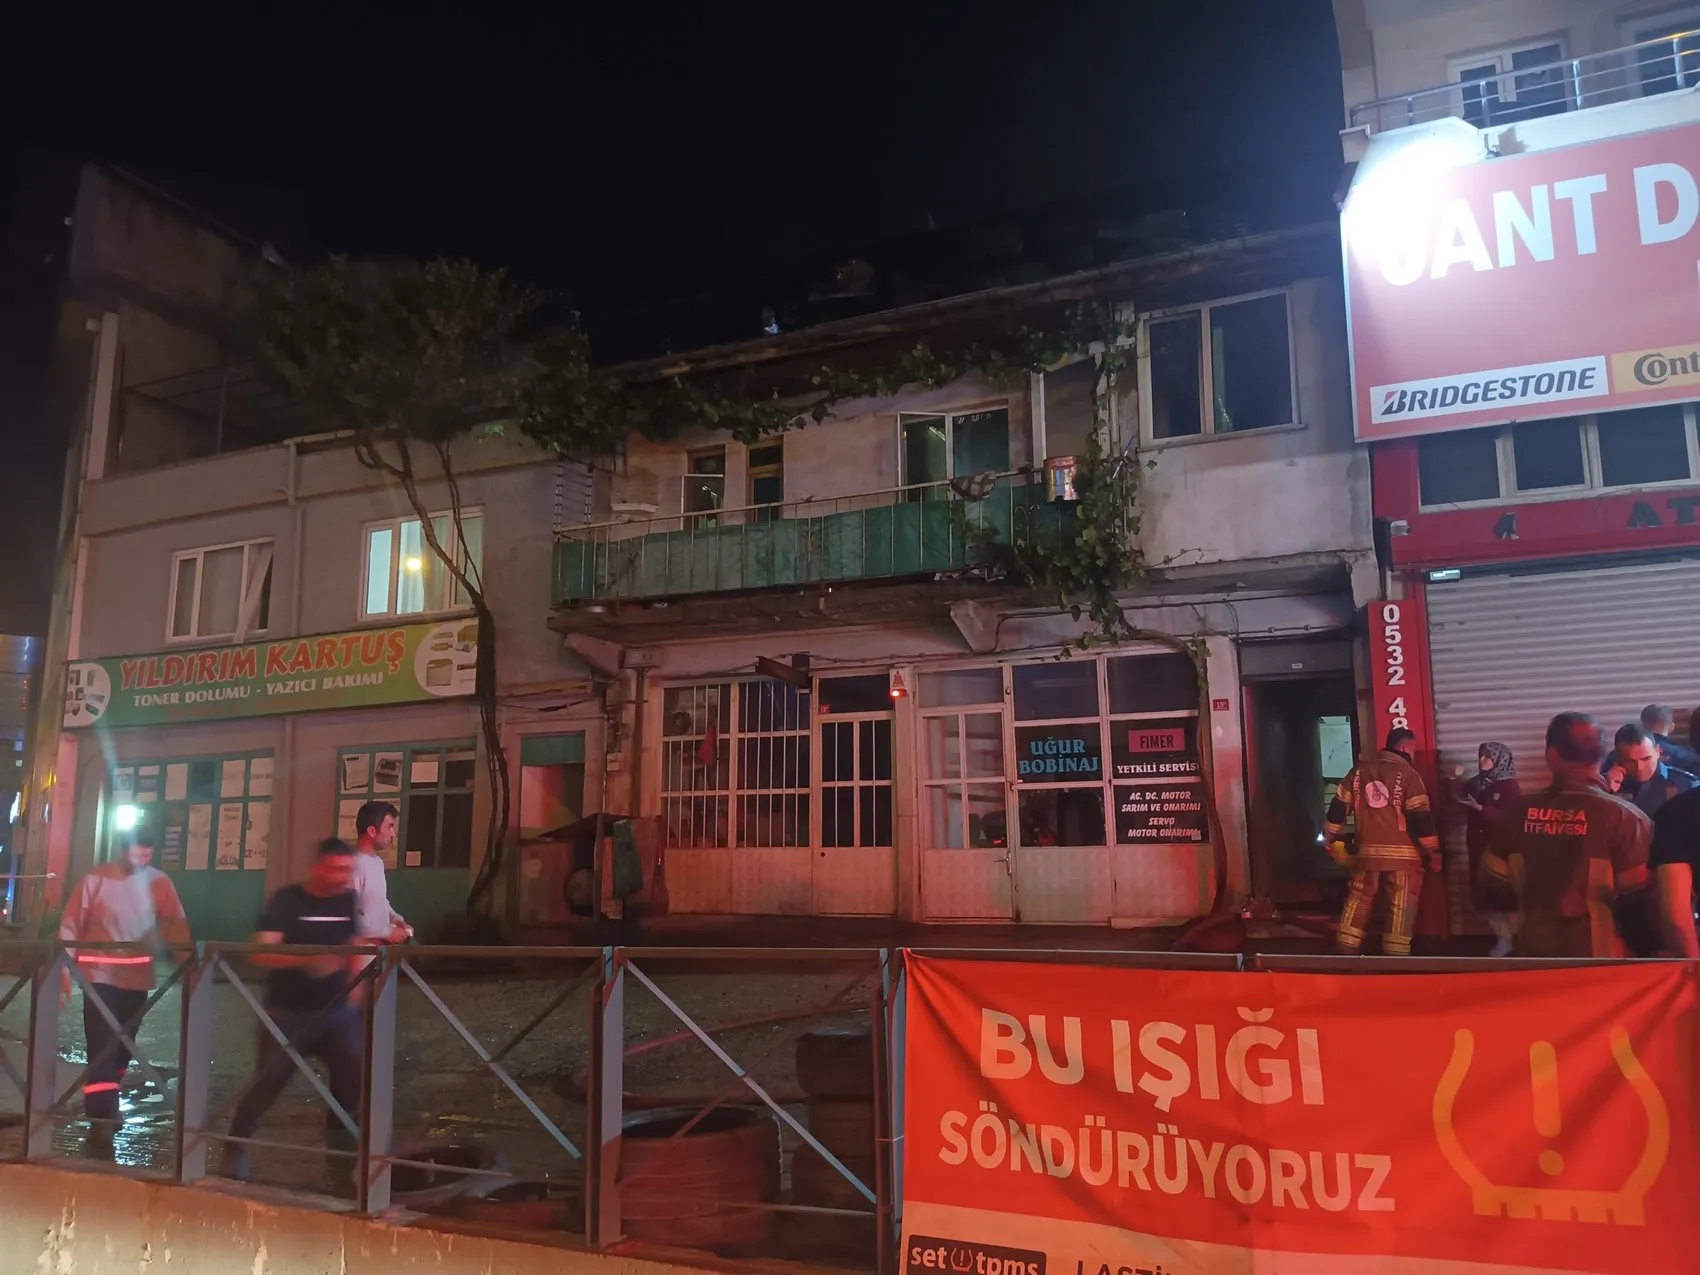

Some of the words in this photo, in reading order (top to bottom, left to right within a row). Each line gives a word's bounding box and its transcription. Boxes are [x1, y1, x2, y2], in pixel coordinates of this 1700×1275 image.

[1633, 352, 1700, 386] Cont
[1381, 367, 1596, 416] BRIDGESTONE
[1383, 604, 1405, 686] 0532
[120, 646, 257, 691] YILDIRIM
[264, 629, 407, 679] KARTUŞ
[133, 692, 180, 707] TONER
[185, 685, 251, 704] DOLUMU
[266, 678, 316, 696] YAZICI
[323, 671, 384, 690] BAKIMI
[1030, 737, 1086, 756] UĞUR
[1140, 735, 1174, 749] FIMER
[1019, 755, 1099, 775] BOBİNAJ
[1116, 762, 1157, 774] YETKİLİ
[1161, 791, 1191, 800] MOTOR
[1121, 803, 1148, 812] SARIM
[1150, 803, 1161, 811] VE
[1163, 803, 1201, 811] ONARIMI
[1527, 807, 1587, 822] BURSA
[1148, 818, 1175, 826] SERVO
[1128, 829, 1157, 837] MOTOR
[980, 1007, 1085, 1085] BU
[1110, 1006, 1324, 1113] IŞIĞI
[938, 1100, 1395, 1212] SÖNDÜRÜYORUZ
[911, 1246, 947, 1269] set
